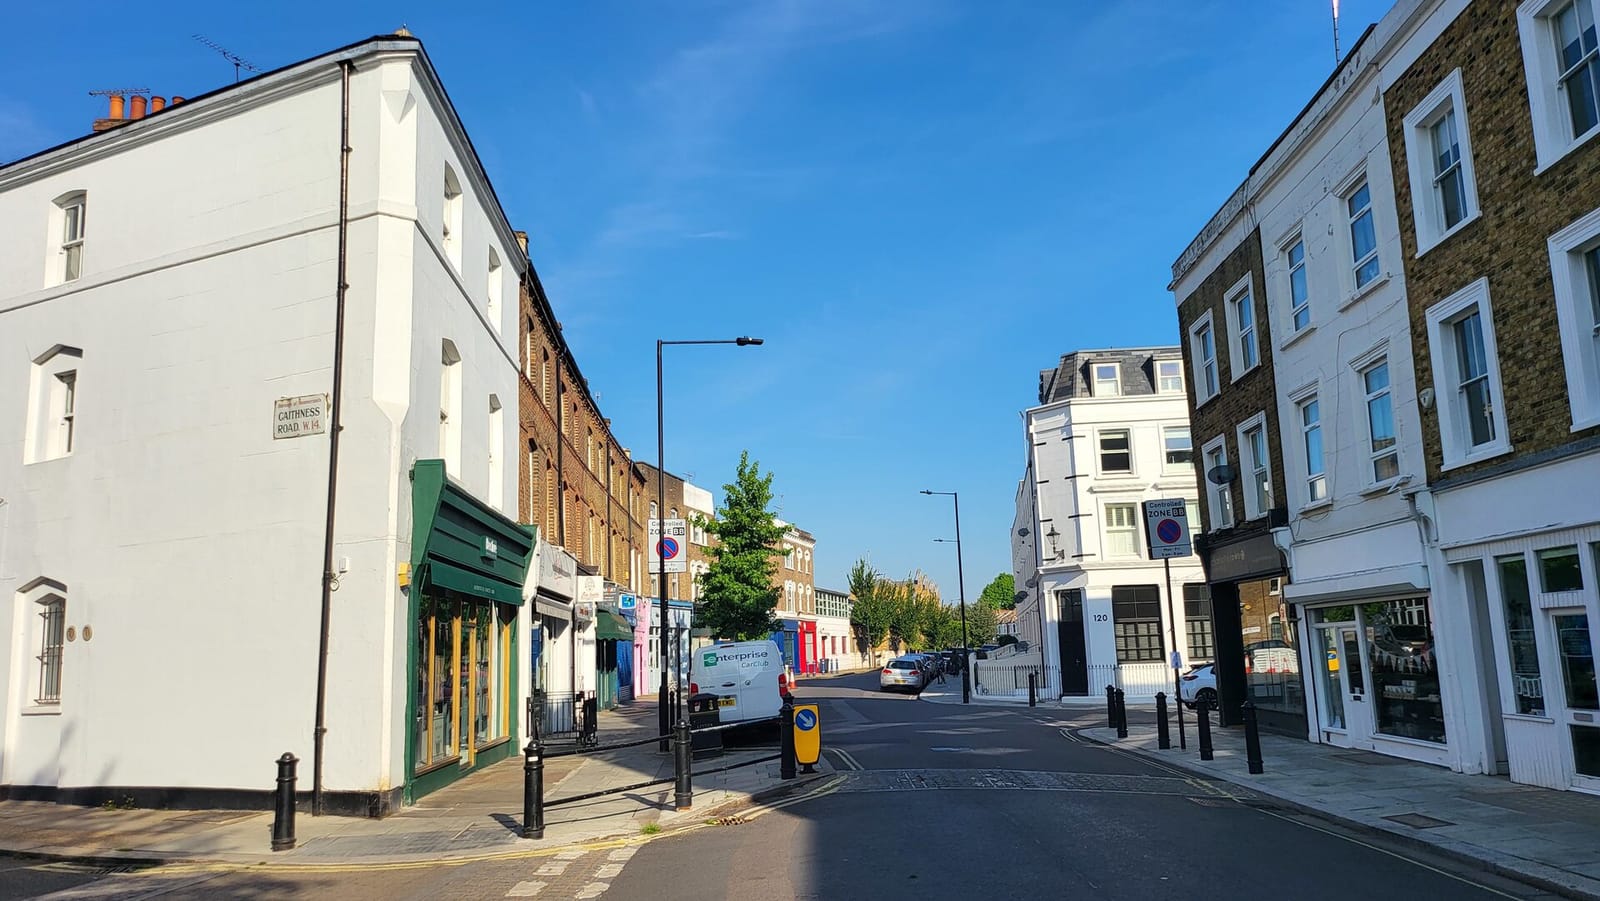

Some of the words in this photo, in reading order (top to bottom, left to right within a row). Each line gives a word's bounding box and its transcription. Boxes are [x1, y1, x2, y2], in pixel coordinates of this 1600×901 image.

[278, 407, 320, 421] CAITHNESS
[1149, 500, 1182, 508] Controlled
[1148, 510, 1171, 518] ZONE
[1173, 508, 1184, 517] BB
[1093, 614, 1108, 622] 120
[708, 651, 768, 662] enterprise
